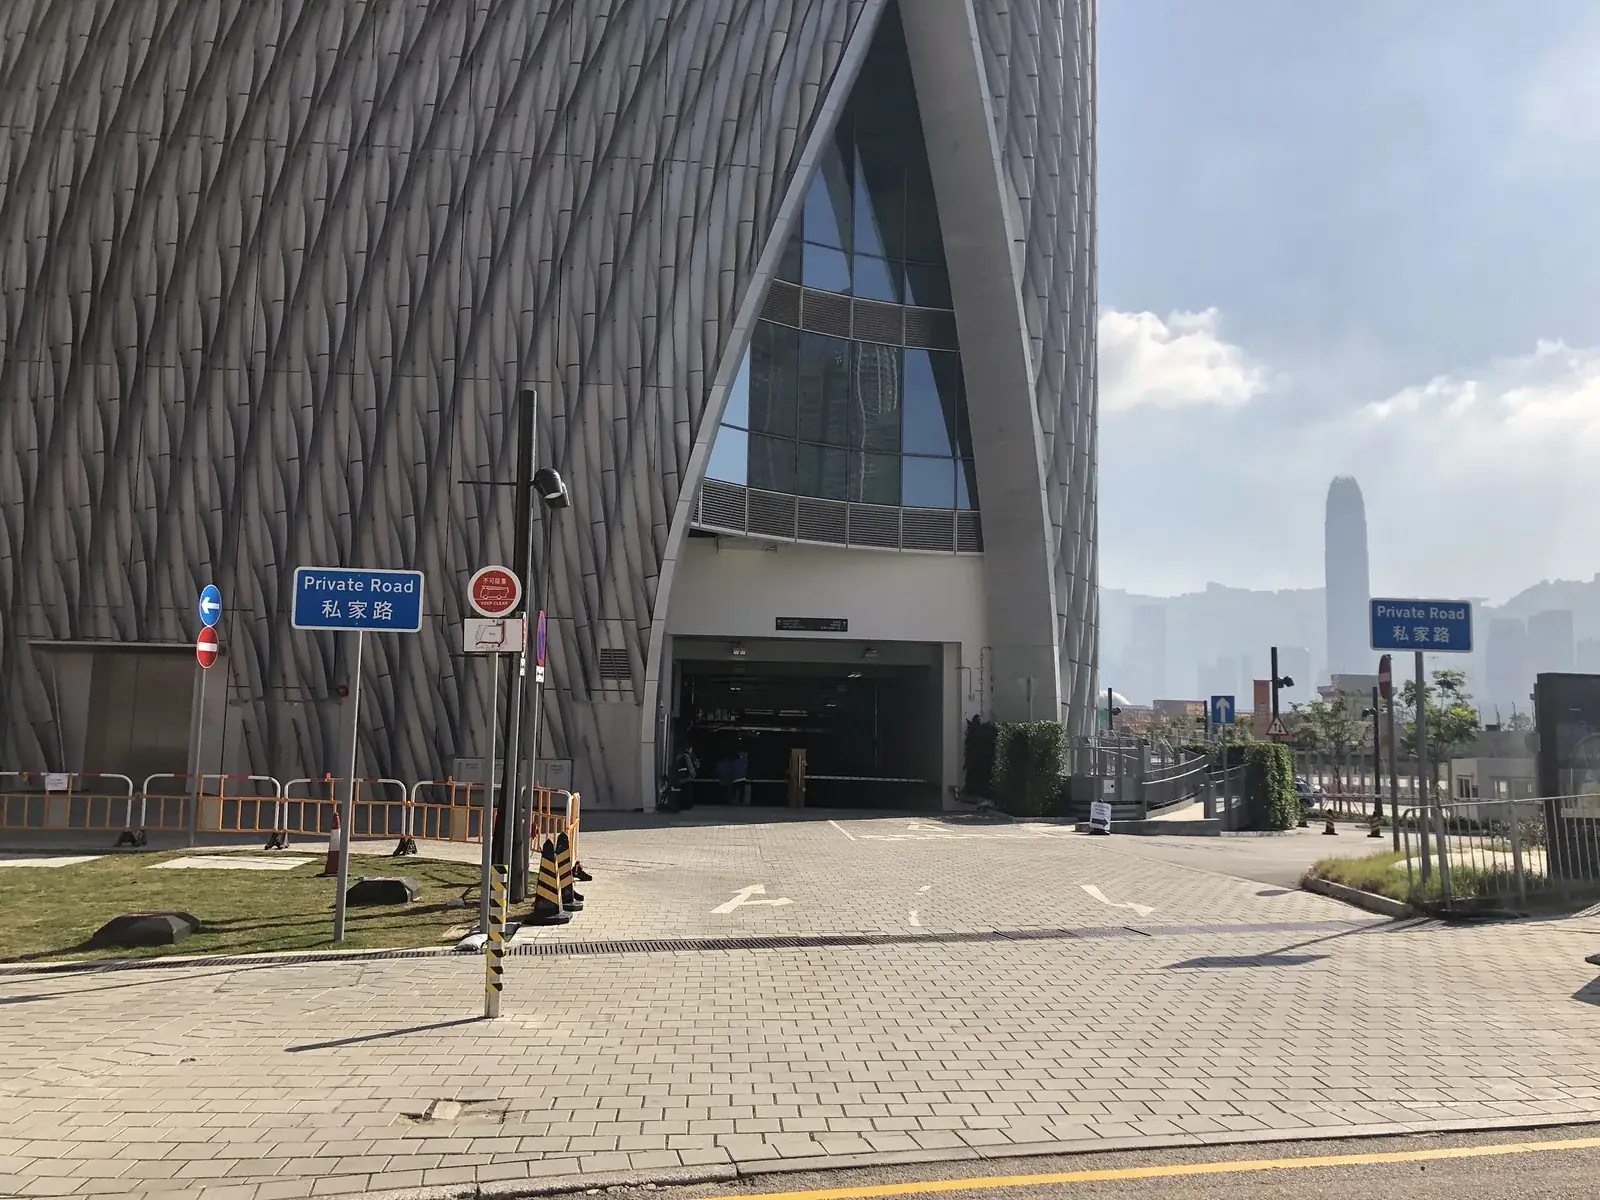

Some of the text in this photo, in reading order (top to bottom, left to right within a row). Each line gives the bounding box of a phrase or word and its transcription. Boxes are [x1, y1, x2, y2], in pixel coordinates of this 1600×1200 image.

[304, 576, 414, 593] Private Road
[321, 599, 393, 621] 私家路
[1377, 605, 1465, 620] Private Road
[1392, 625, 1451, 643] 私家路
